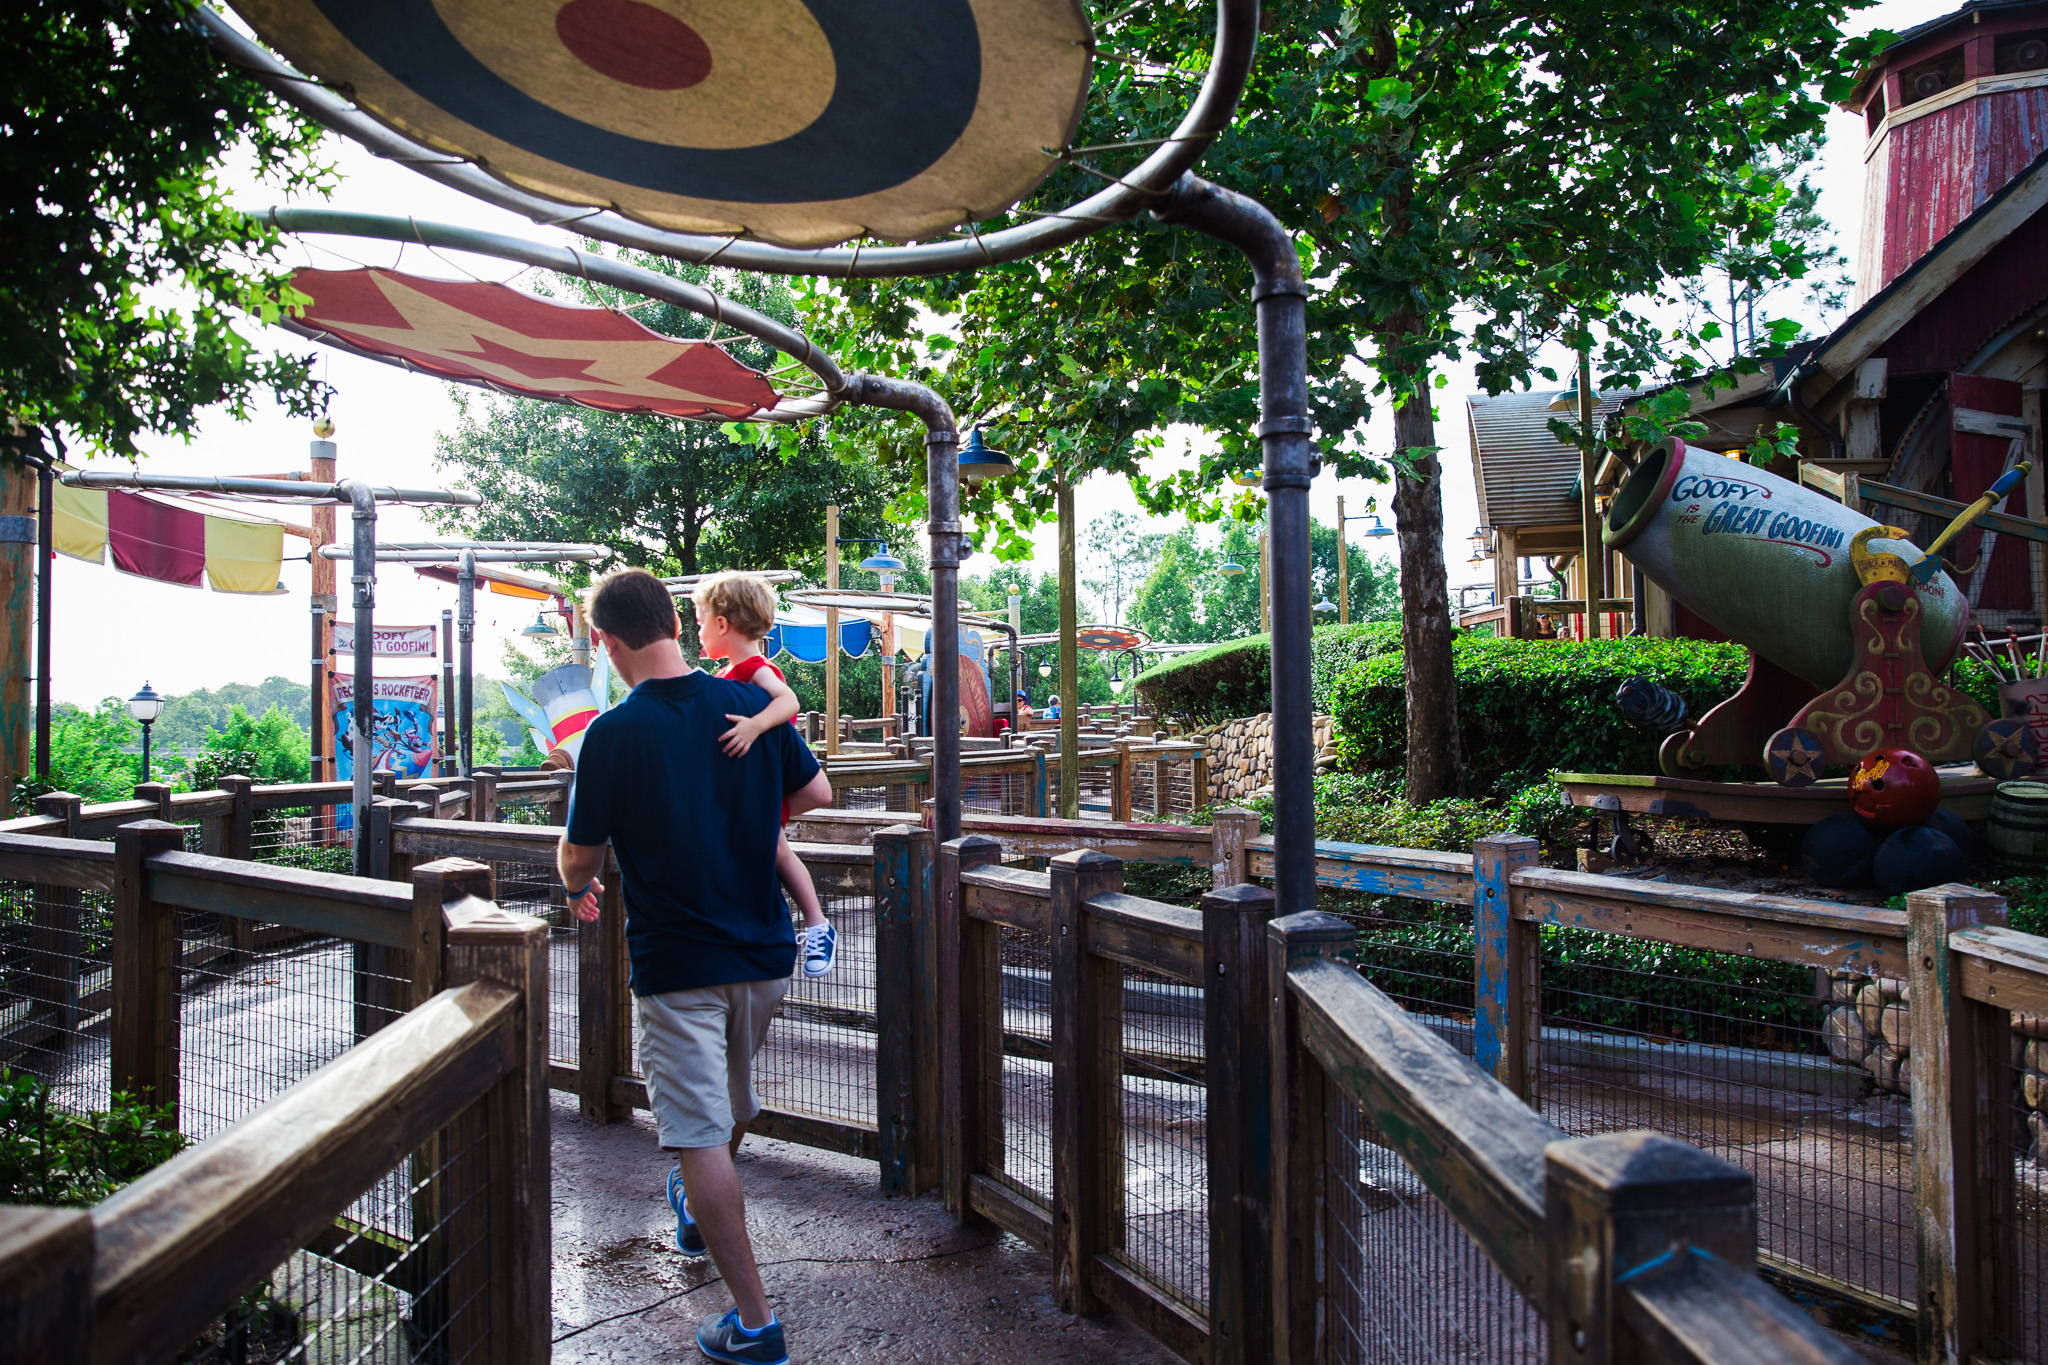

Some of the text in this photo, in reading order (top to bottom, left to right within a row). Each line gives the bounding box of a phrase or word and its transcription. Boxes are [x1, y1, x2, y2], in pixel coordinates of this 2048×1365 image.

[1672, 476, 1758, 502] GOOFY
[1685, 504, 1700, 513] IS
[1676, 515, 1701, 524] THE
[1702, 501, 1773, 535] GREAT
[1768, 512, 1845, 548] GOOFINI
[1913, 580, 1944, 598] MOON!
[373, 632, 407, 640] OOFY
[336, 683, 430, 702] RECS ROCKETEER
